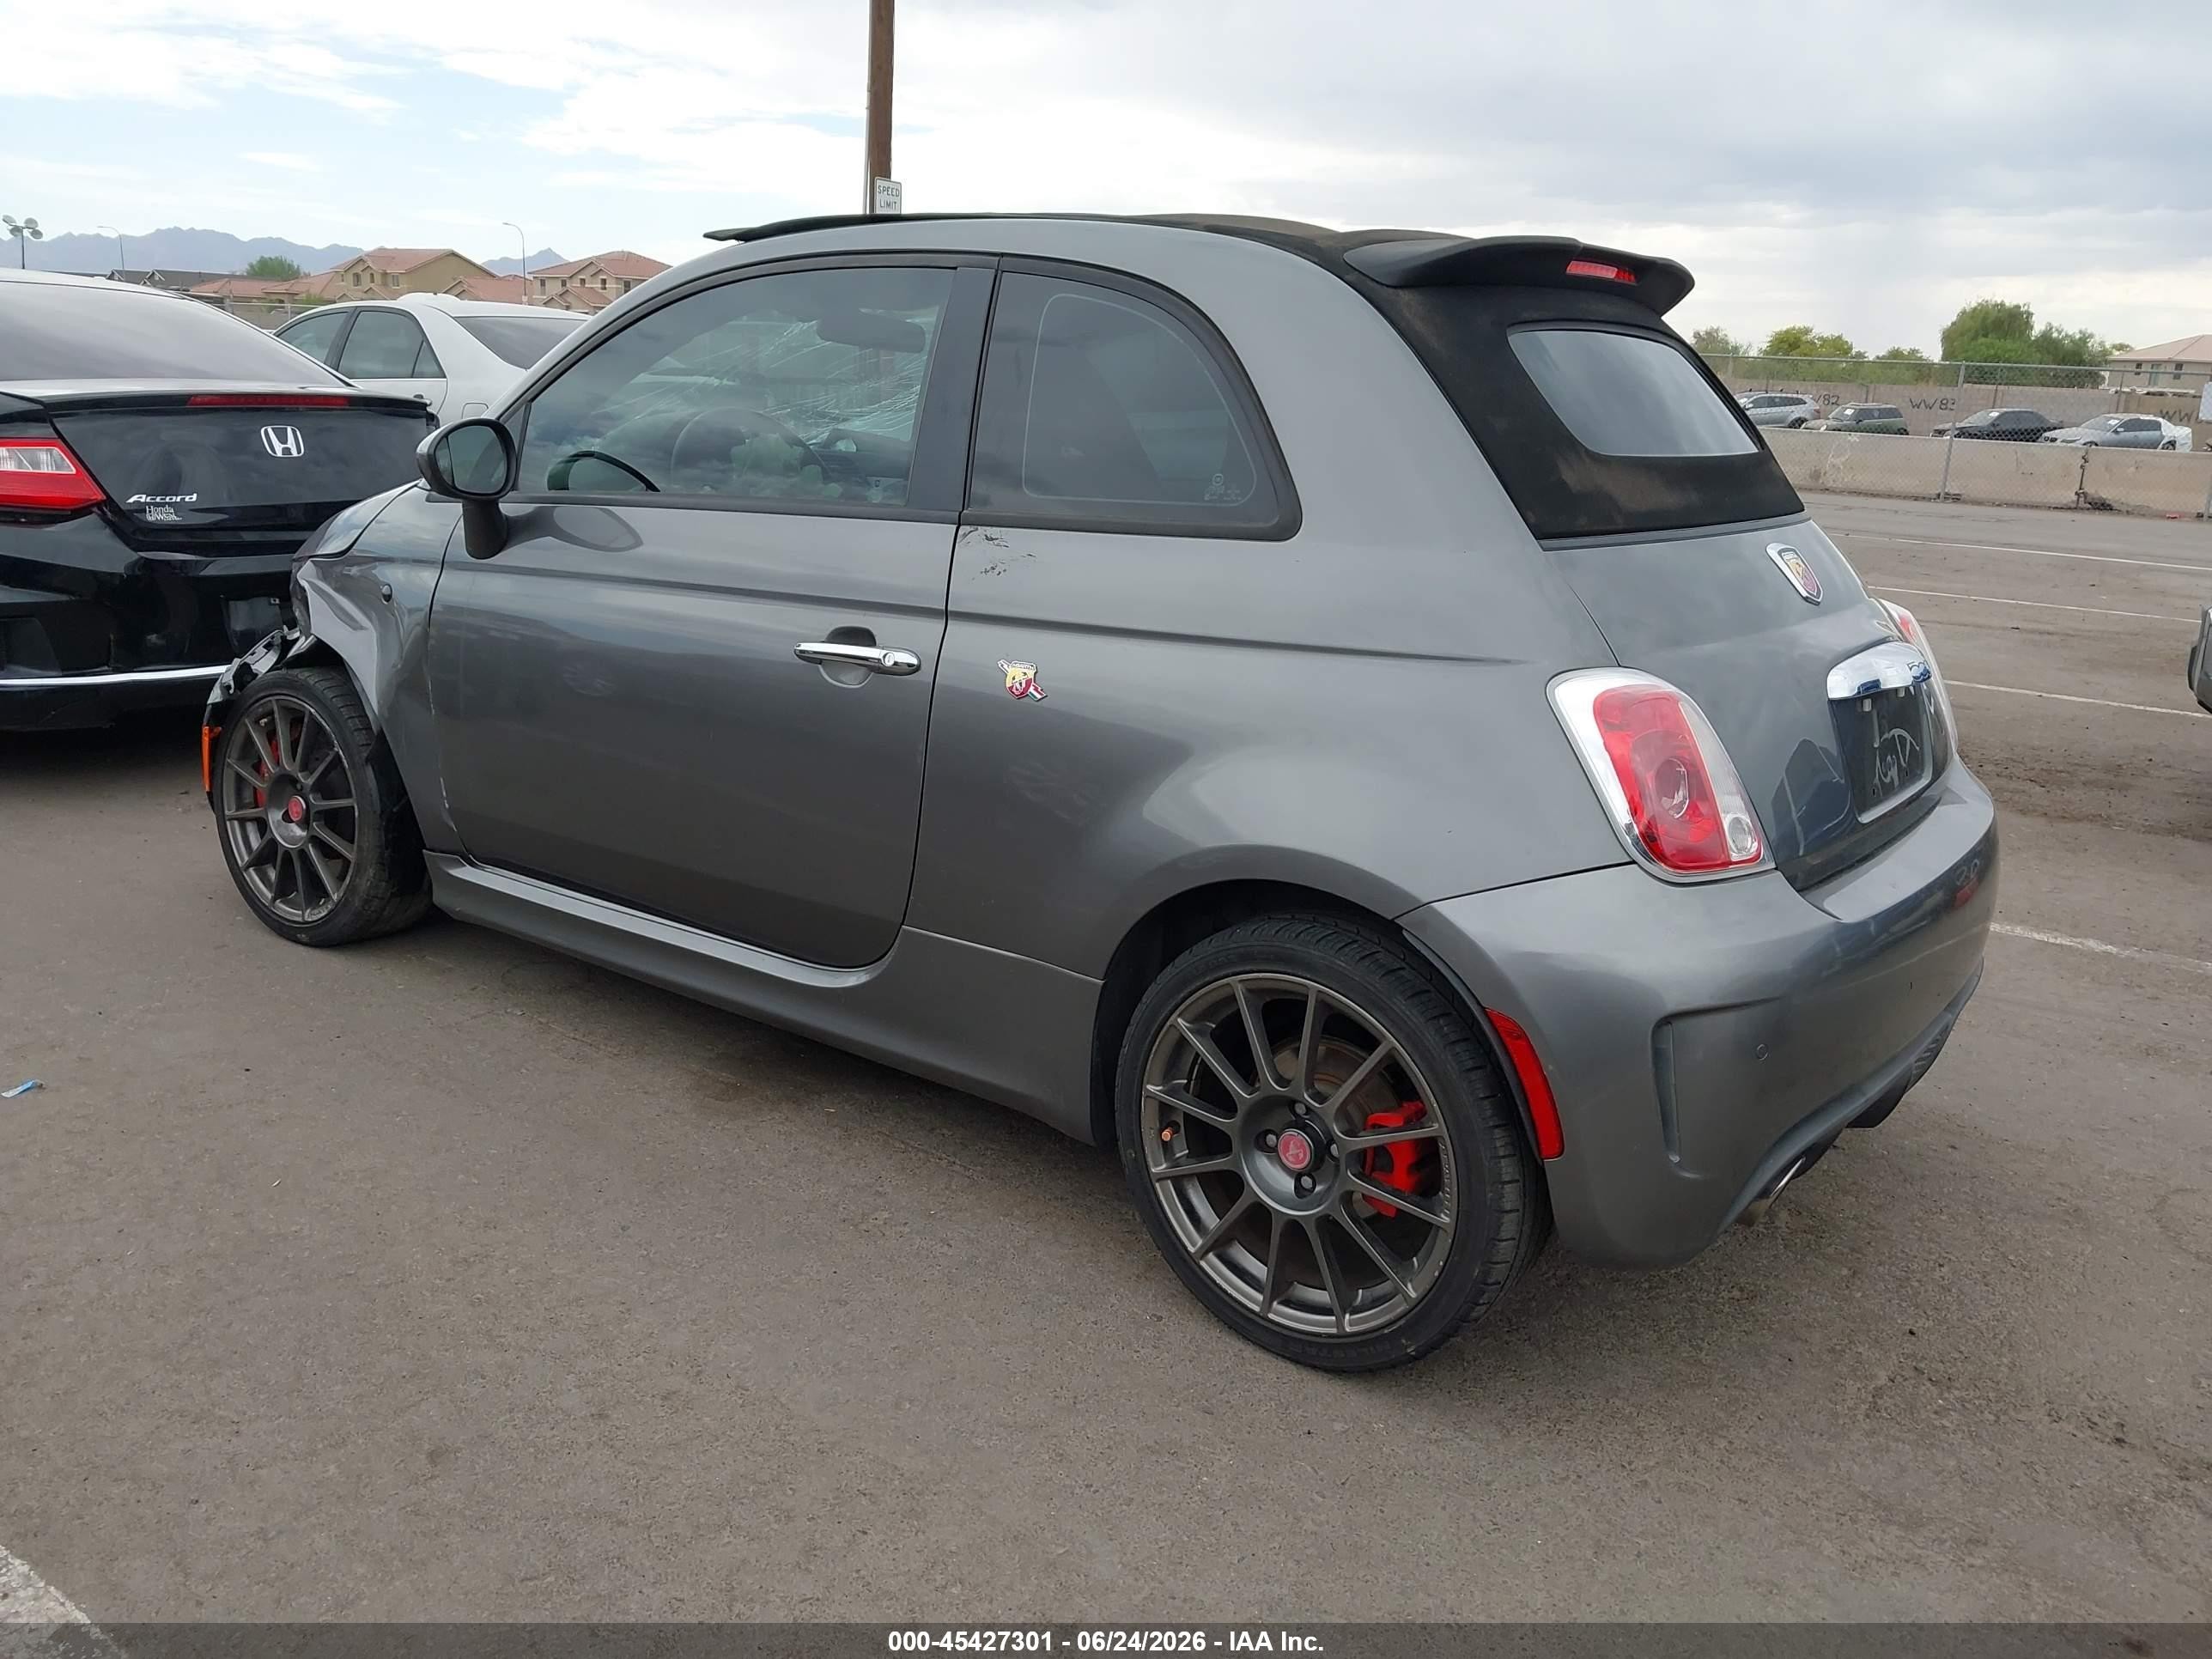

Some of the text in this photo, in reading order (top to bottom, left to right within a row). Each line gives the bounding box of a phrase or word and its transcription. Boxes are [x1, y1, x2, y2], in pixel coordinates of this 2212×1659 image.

[877, 185, 900, 198] SPEED
[879, 199, 897, 210] LIMIT
[125, 493, 198, 503] Accord
[146, 504, 174, 514] Honda
